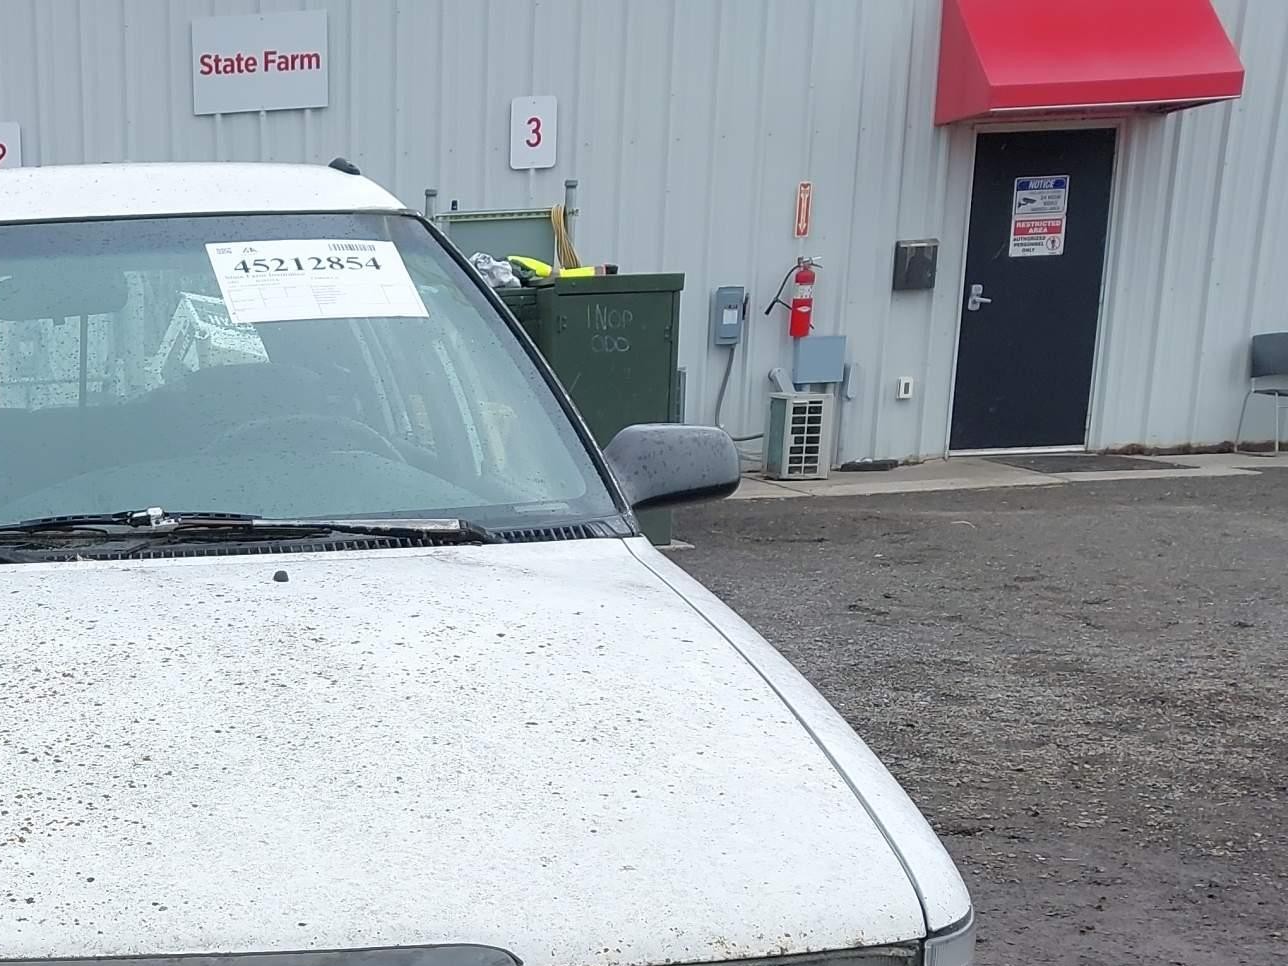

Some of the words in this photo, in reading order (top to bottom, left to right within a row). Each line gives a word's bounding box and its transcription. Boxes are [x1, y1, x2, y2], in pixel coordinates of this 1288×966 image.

[199, 53, 258, 76] State
[263, 50, 321, 72] Farm
[525, 117, 542, 148] 3
[1028, 179, 1055, 190] NOTICE
[1015, 220, 1062, 228] RESTRICTED
[233, 256, 382, 274] 45212854
